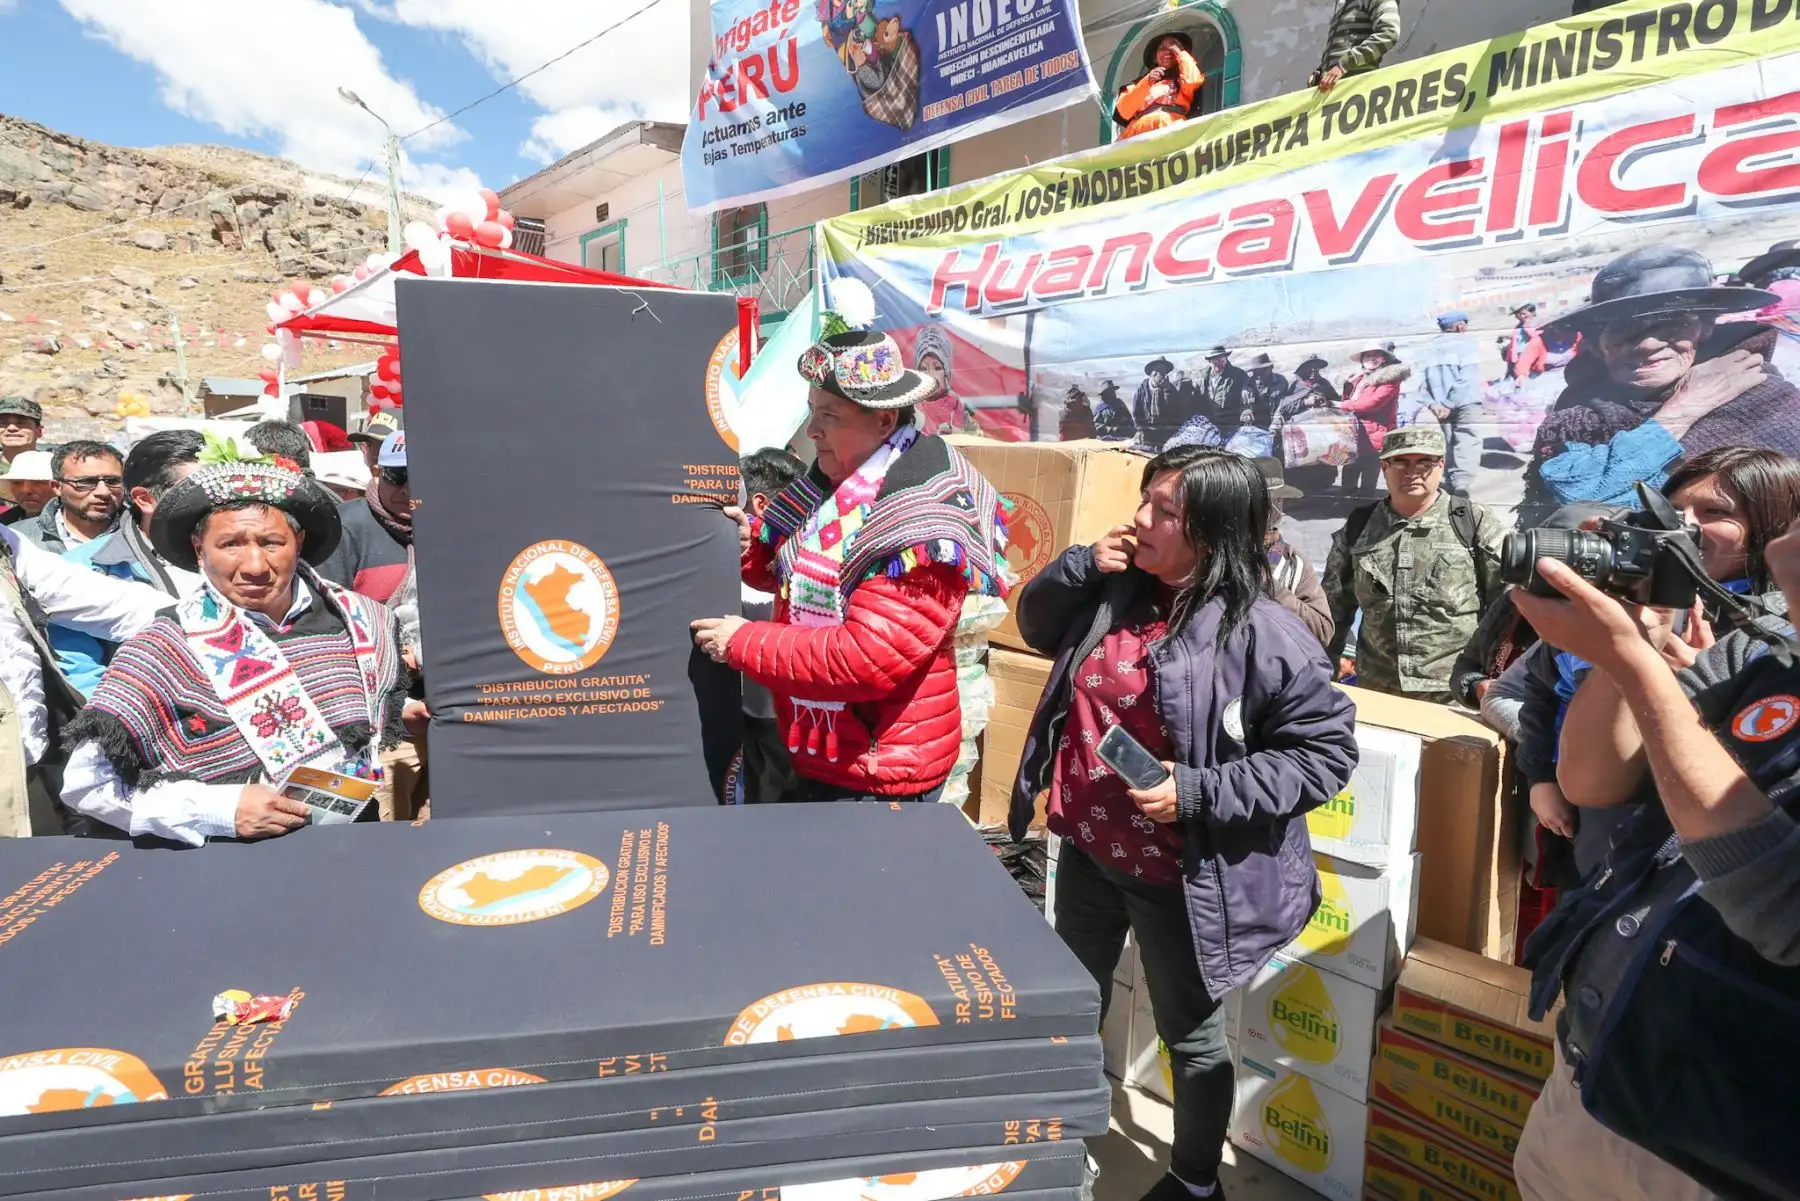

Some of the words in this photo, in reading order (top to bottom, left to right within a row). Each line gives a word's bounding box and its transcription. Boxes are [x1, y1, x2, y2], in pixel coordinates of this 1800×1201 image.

[938, 44, 966, 60] INSTITUTO
[967, 33, 996, 52] NACIONAL
[996, 26, 1005, 36] DE
[1005, 13, 1035, 32] DEFENSA
[1035, 6, 1052, 17] CIVIL
[979, 21, 1056, 62] DESCONCENTRADA
[698, 29, 799, 121] PERÚ
[951, 69, 975, 86] INDECI
[981, 40, 1044, 75] HUANCAVELICA
[965, 84, 989, 107] CIVIL
[990, 71, 1024, 98] TAREA
[1024, 64, 1040, 86] DE
[1040, 49, 1079, 80] TODOS!
[702, 116, 761, 148] Actuamos
[766, 101, 806, 125] ante
[730, 125, 807, 158] Temperaturas
[865, 205, 968, 247] BIENVENIDO
[971, 194, 1011, 231] Gral.
[1014, 172, 1068, 223] JOSÉ
[1071, 150, 1188, 210] MODESTO
[1195, 112, 1310, 178] HUERTA
[1321, 62, 1475, 142] TORRES,
[1486, 0, 1738, 98] MINISTRO
[1750, 0, 1800, 32] D
[708, 364, 729, 433] INSTITUTO
[684, 479, 724, 490] "PARA
[1023, 501, 1051, 546] NACIONAL
[507, 542, 567, 585] NACIONAL
[569, 544, 589, 561] DE
[588, 558, 617, 614] DEFENSA
[502, 586, 526, 651] INSTITUTO
[597, 617, 616, 646] CIVIL
[475, 679, 577, 694] "DISTRIBUCION
[581, 674, 650, 688] GRATUITA"
[477, 696, 520, 707] "PARA
[524, 693, 552, 705] USO
[556, 690, 630, 703] EXCLUSIVO
[633, 688, 651, 698] DE
[463, 704, 567, 722] DAMNIFICADOS
[570, 705, 578, 716] Y
[581, 701, 665, 715] AFECTADOS"
[640, 828, 652, 840] DE
[655, 821, 670, 867] AFECTADOS"
[66, 860, 93, 873] DE
[635, 840, 651, 882] EXCLUSIVO
[654, 866, 666, 874] Y
[632, 884, 647, 903] USO
[650, 874, 667, 945] DAMNIFICADOS
[629, 905, 646, 936] "PARA
[955, 954, 976, 969] DE
[730, 1016, 757, 1044] DE
[752, 985, 846, 1017] DEFENSA
[851, 985, 900, 1001] CIVIL
[1271, 999, 1338, 1044] Belini
[68, 1051, 122, 1071] CIVIL
[1455, 1019, 1543, 1067] Belini
[1433, 1058, 1519, 1112] Belini
[1265, 1106, 1328, 1155] Belini
[1424, 1141, 1507, 1201] Belini
